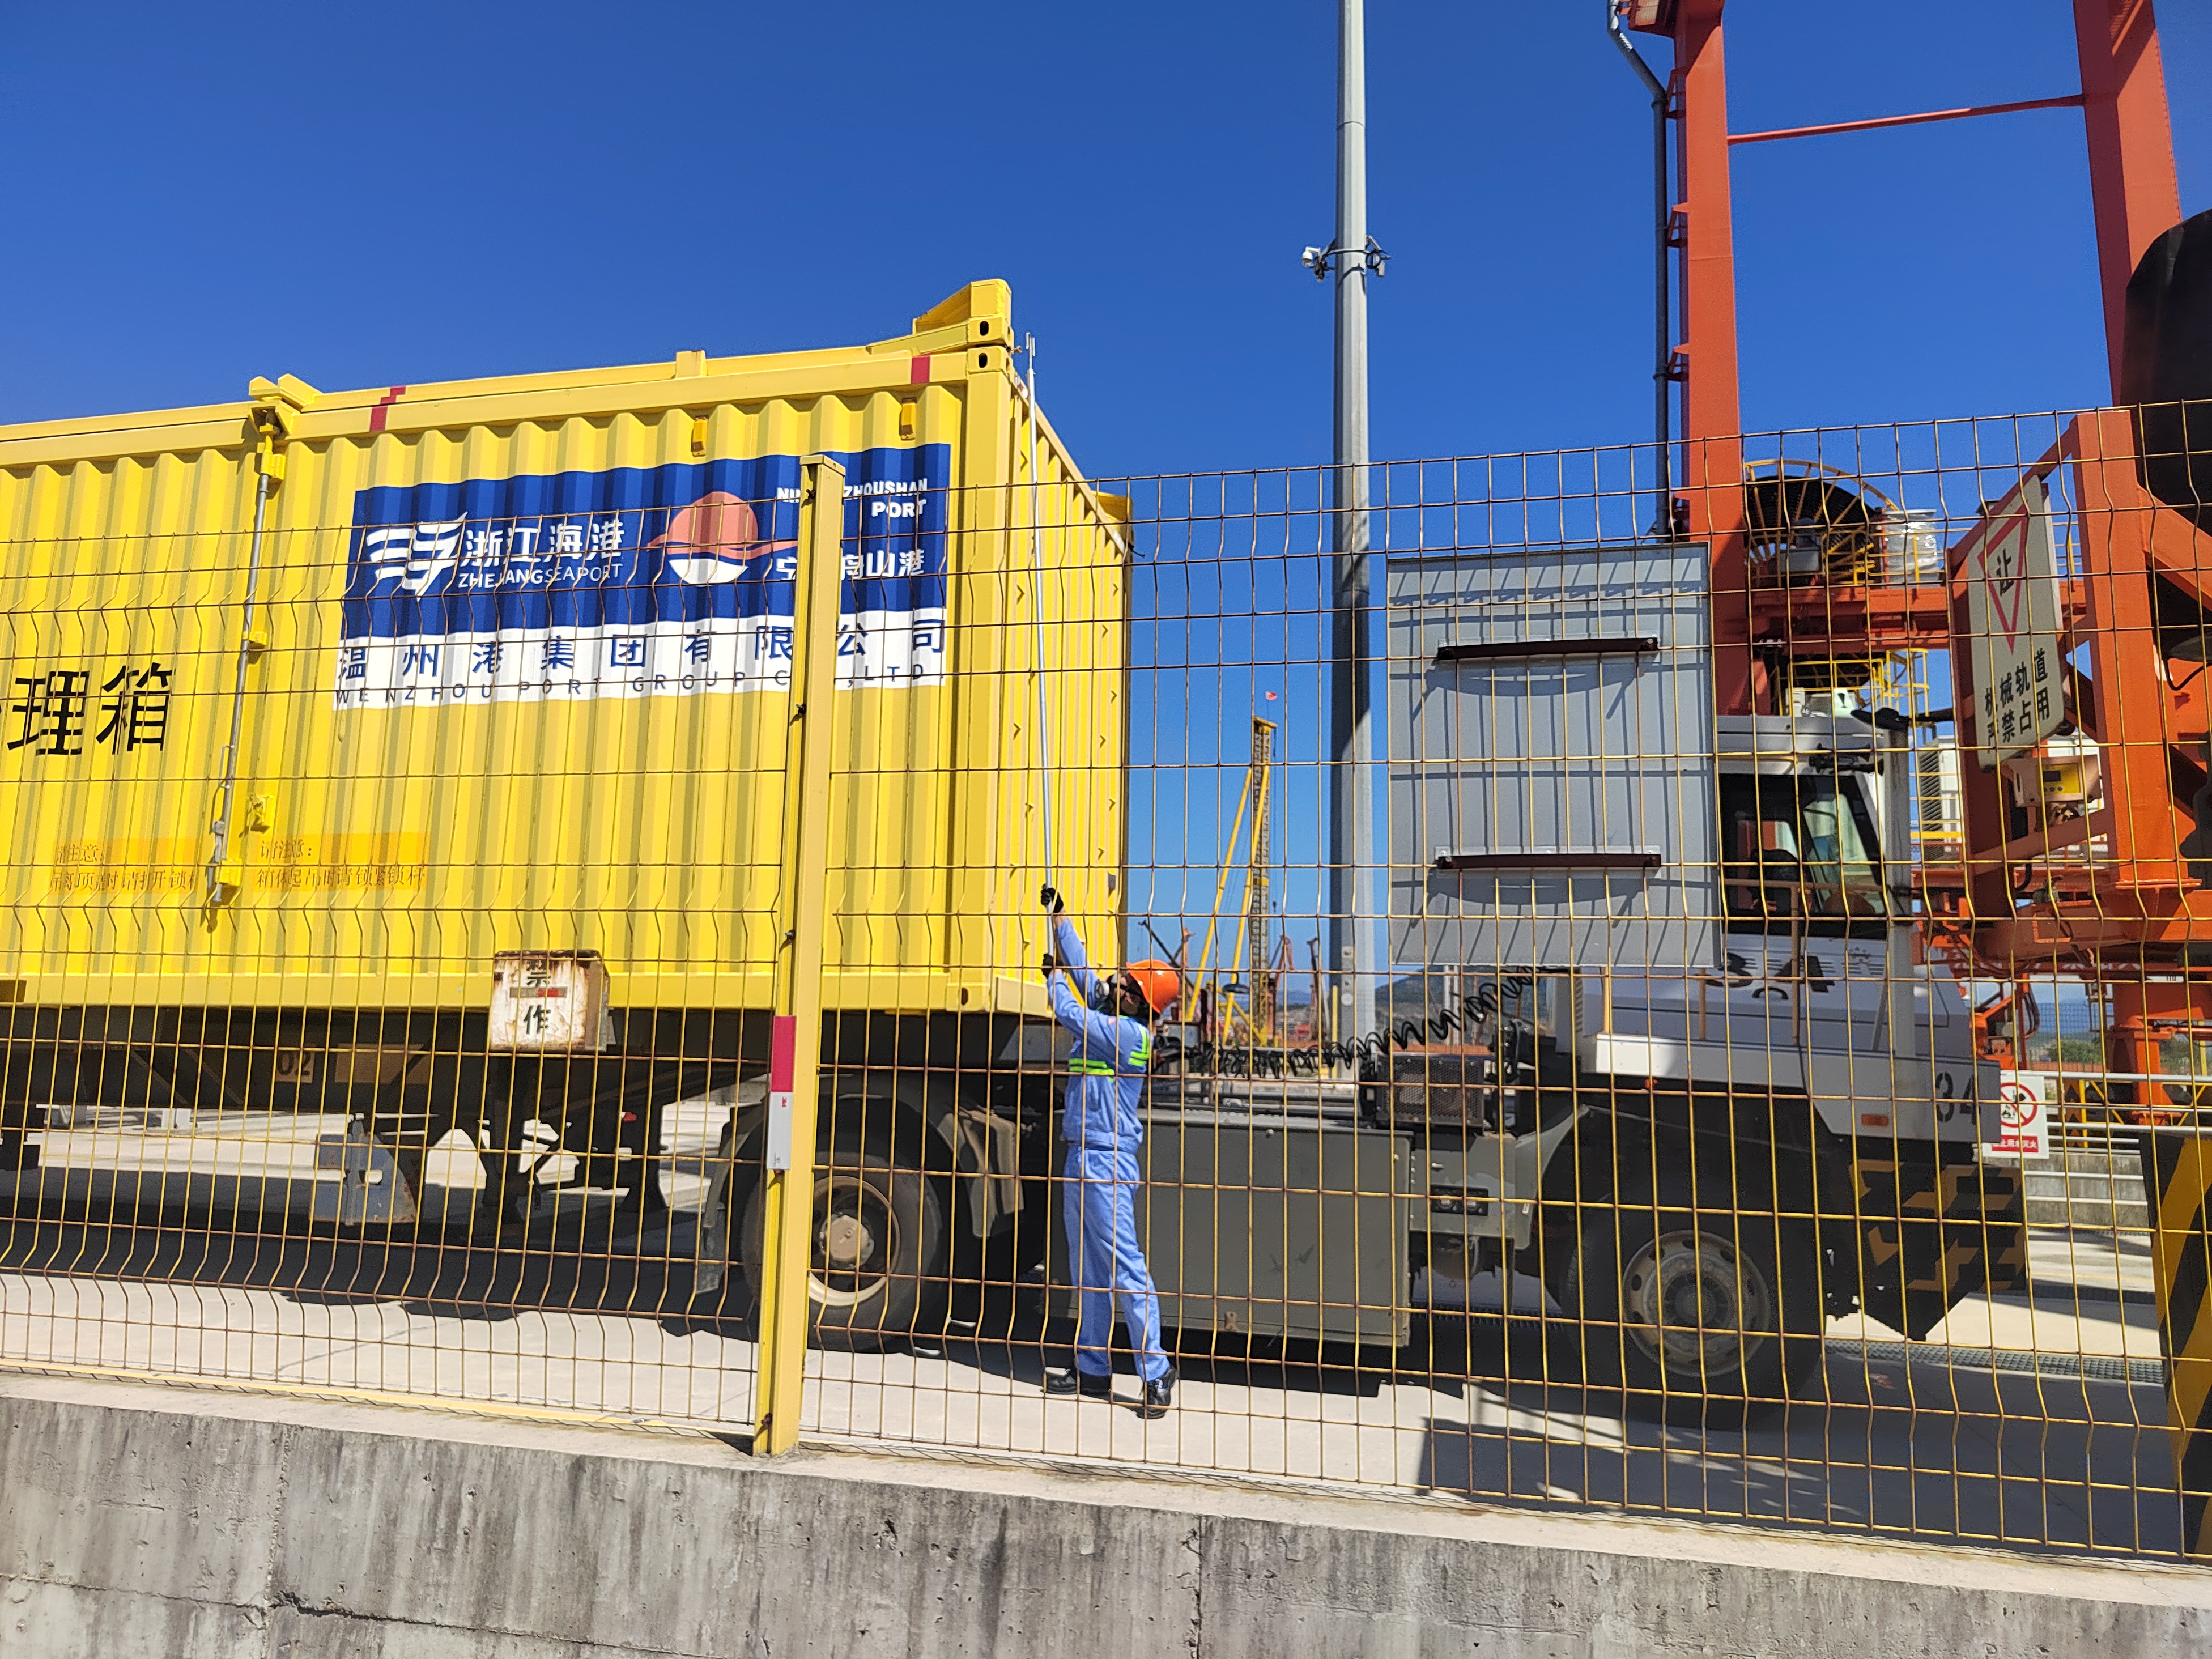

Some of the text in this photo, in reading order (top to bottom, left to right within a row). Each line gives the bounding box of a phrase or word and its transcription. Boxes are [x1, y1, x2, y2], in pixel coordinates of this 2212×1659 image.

[871, 499, 926, 518] PORT
[460, 519, 624, 567] 浙江海港
[776, 549, 924, 581] 宁舟山港
[458, 564, 623, 588] ZHEJANGSEAPORT
[1996, 548, 2014, 596] 让
[338, 619, 945, 679] 温州港集团有限公司
[632, 671, 746, 692] GROUP
[1985, 648, 2048, 718] 机械轨道
[0, 662, 175, 755] 理箱
[1987, 687, 2050, 754] 严禁占用
[1935, 1072, 1981, 1125] 34
